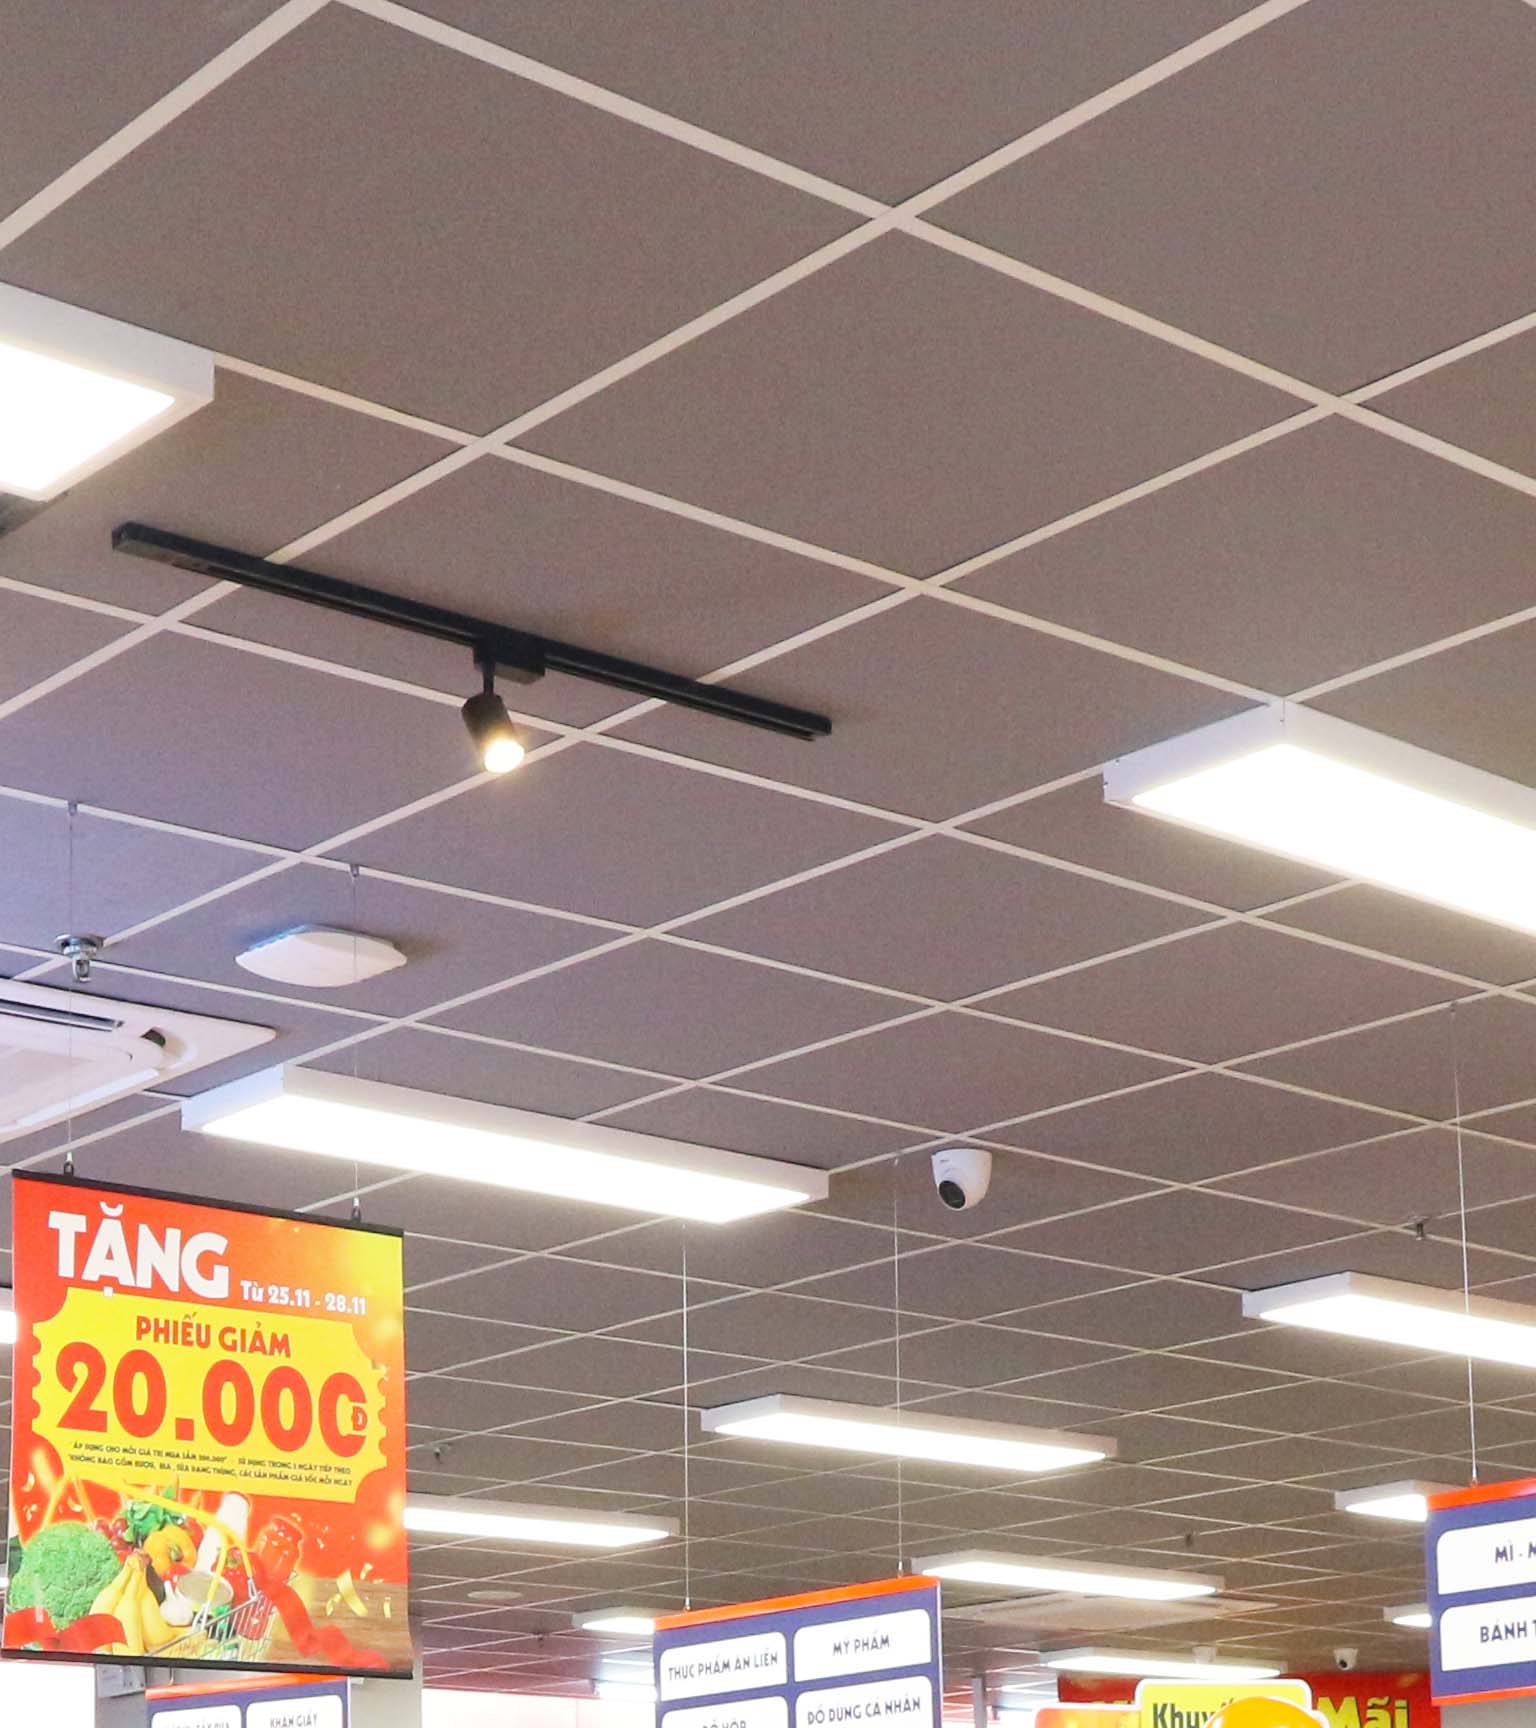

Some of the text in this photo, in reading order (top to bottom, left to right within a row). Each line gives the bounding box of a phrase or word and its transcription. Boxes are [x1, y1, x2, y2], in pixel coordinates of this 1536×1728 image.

[49, 1201, 229, 1298] TẶNG
[240, 1280, 264, 1302] Từ
[268, 1285, 310, 1307] 25.11
[325, 1293, 366, 1315] 28.11
[136, 1312, 291, 1358] PHIẾU GIẢM
[1480, 1617, 1528, 1643] BÁNH
